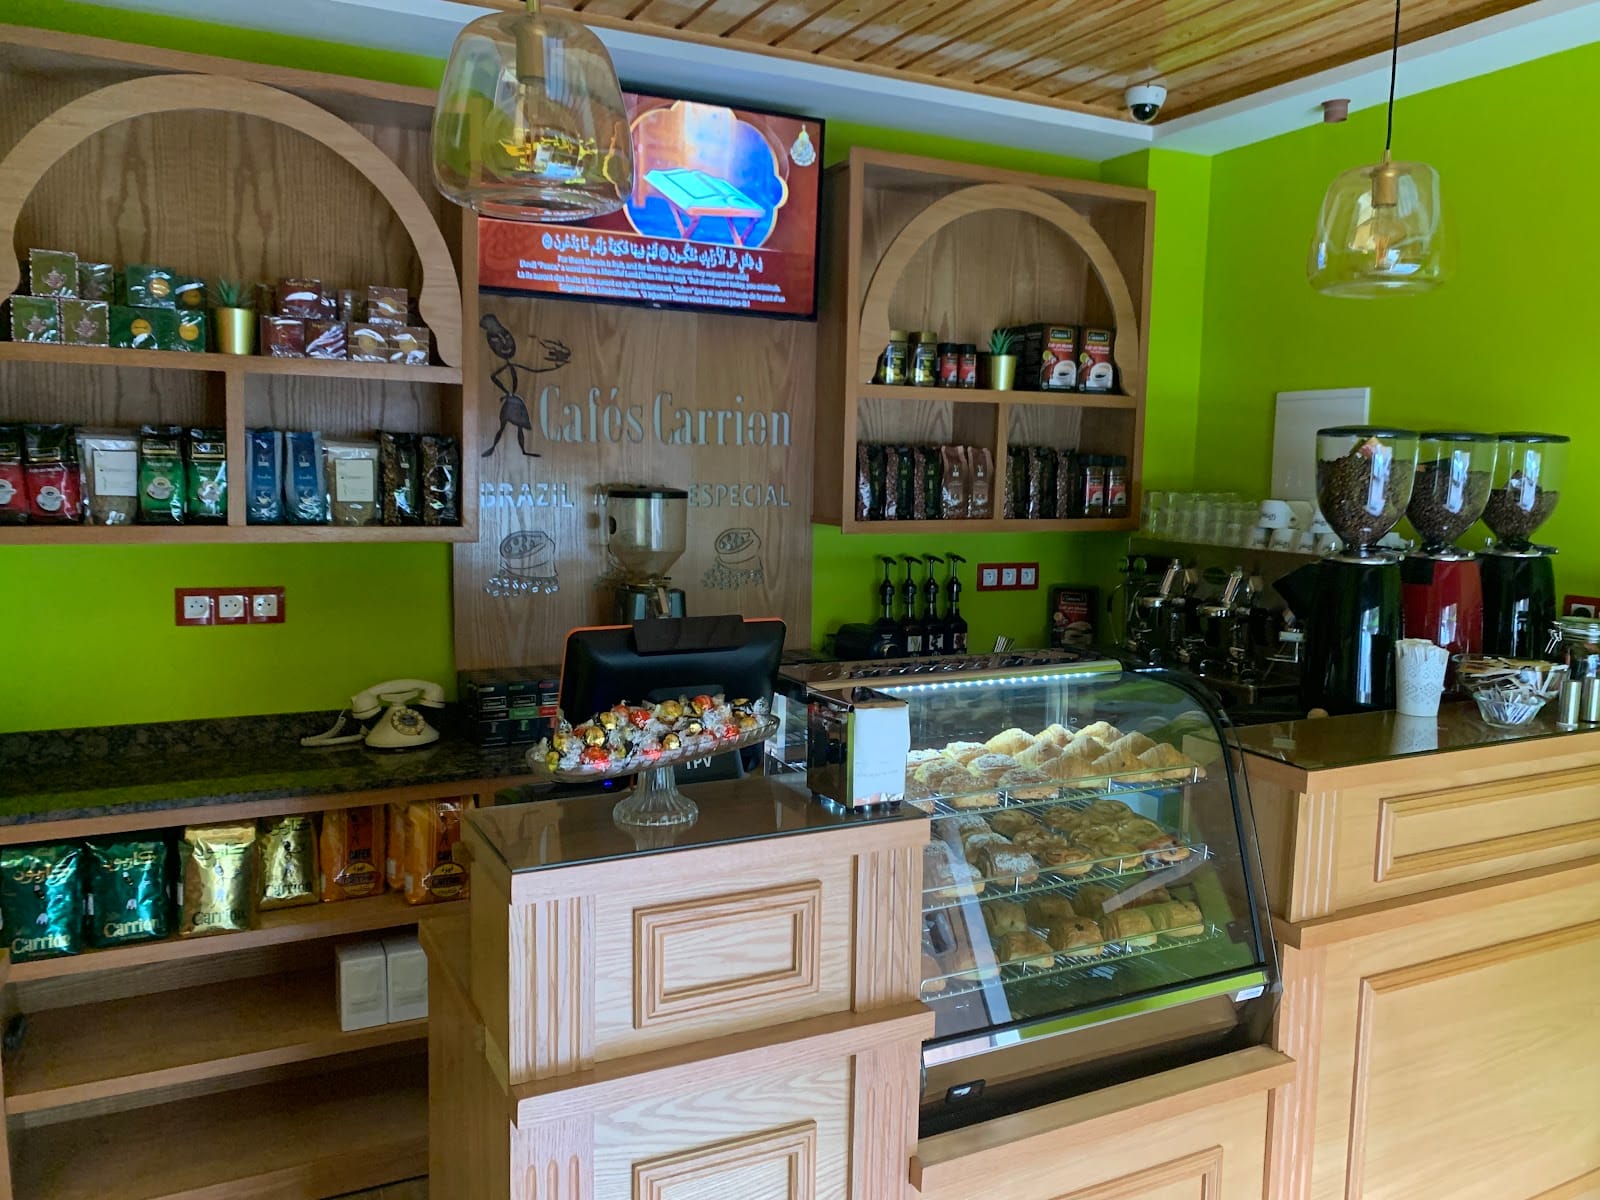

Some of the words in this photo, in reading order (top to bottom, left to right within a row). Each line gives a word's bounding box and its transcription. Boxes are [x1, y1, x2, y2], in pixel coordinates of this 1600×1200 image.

[539, 384, 645, 444] Cafés
[652, 390, 792, 448] Carrion
[479, 481, 575, 509] BRAZIL
[687, 482, 792, 508] ESPECIAL
